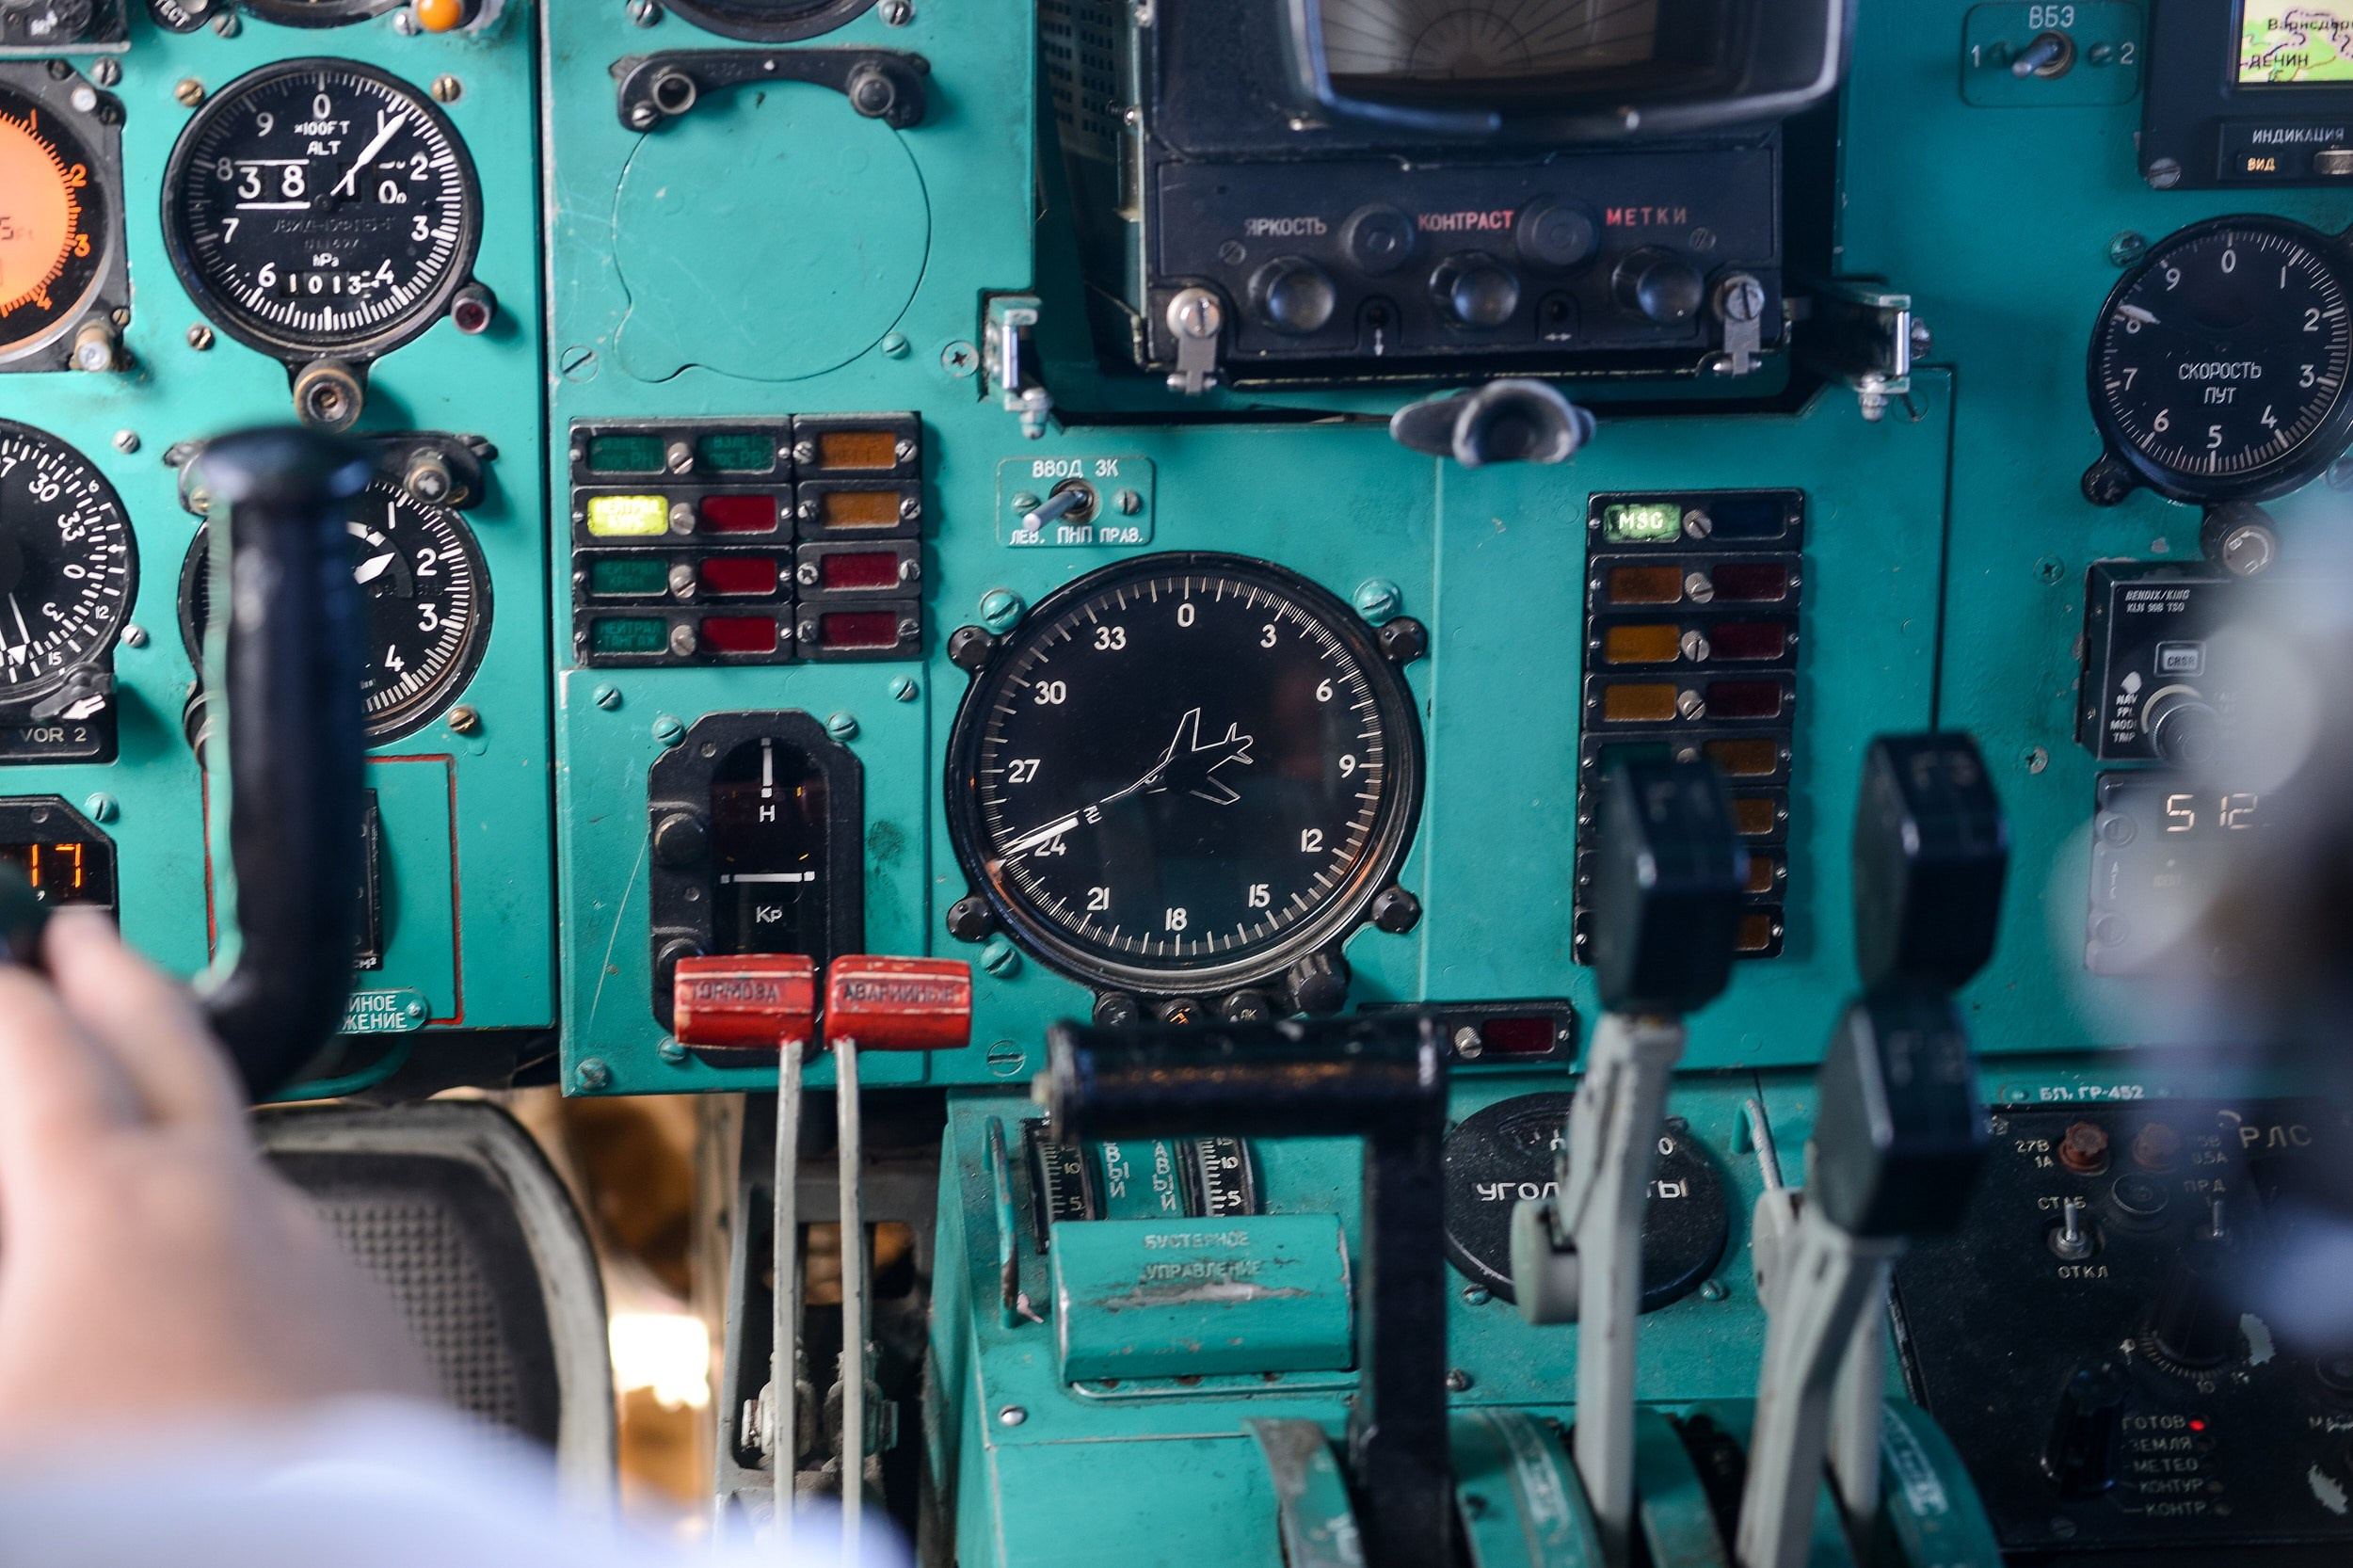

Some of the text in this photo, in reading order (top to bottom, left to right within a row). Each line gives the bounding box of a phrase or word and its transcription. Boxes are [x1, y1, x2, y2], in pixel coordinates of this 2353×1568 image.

[1972, 44, 1980, 68] 1
[2121, 41, 2135, 64] 2
[312, 94, 331, 120] 0
[257, 112, 274, 136] 9
[2252, 128, 2344, 144] ИНДИКАЦИЯ
[307, 140, 341, 155] ALT
[216, 157, 233, 181] 8
[409, 152, 429, 181] 2
[2248, 157, 2275, 171] ВИД
[1244, 216, 1327, 236] ЯРКОСТЬ
[1417, 209, 1513, 232] КОНТРАСТ
[1606, 207, 1687, 226] МЕТКИ
[221, 217, 240, 244] 7
[411, 216, 430, 241] 3
[312, 253, 340, 267] hPa
[2221, 248, 2236, 273] 0
[258, 262, 277, 287] 6
[376, 259, 394, 285] 4
[2166, 268, 2182, 292] 9
[2280, 265, 2287, 289] 1
[2303, 308, 2320, 331] 2
[2122, 368, 2138, 392] 7
[2178, 361, 2263, 380] СКОРОСТЬ
[2299, 364, 2315, 389] 3
[2203, 387, 2237, 405] ПУТ
[2153, 408, 2170, 433] 6
[2261, 405, 2278, 428] 4
[2206, 424, 2222, 449] 5
[1032, 459, 1118, 478] ВВОД ЗК
[28, 472, 60, 502] 30
[57, 510, 86, 542] 33
[388, 501, 395, 530] 1
[1618, 511, 1663, 530] MSG
[1057, 526, 1092, 545] ПНП
[1099, 527, 1143, 543] ПРАВ.
[63, 565, 86, 579] 0
[417, 548, 437, 576] 2
[2125, 589, 2191, 601] BENDIX/KING
[41, 601, 65, 621] 3
[95, 605, 109, 619] 12
[418, 603, 439, 632] 3
[1177, 603, 1195, 627] 0
[1095, 627, 1126, 650] 33
[1260, 624, 1277, 648] 3
[48, 651, 62, 665] 15
[385, 644, 405, 672] 4
[1034, 680, 1066, 704] 30
[1316, 679, 1333, 702] 6
[2116, 695, 2137, 706] NAV
[22, 728, 88, 743] VOR 2
[2112, 732, 2137, 743] TRIP
[1008, 760, 1040, 783] 27
[1339, 755, 1356, 777] 9
[759, 806, 776, 823] Н
[1034, 834, 1066, 856] 24
[1302, 829, 1323, 852] 12
[1088, 888, 1110, 910] 21
[1249, 885, 1271, 907] 15
[756, 905, 783, 924] Кр
[1165, 908, 1187, 931] 18
[692, 984, 780, 1003] ТОРМОЗА
[2078, 1085, 2145, 1100] ГР-452
[2015, 1140, 2050, 1153] 27В
[2240, 1125, 2313, 1149] РЛС
[1064, 1161, 1081, 1175] 10
[1103, 1142, 1130, 1199] ВЫЙ
[1222, 1157, 1239, 1169] 10
[2035, 1155, 2055, 1168] 1А
[1069, 1196, 1082, 1210] 5
[1227, 1191, 1241, 1207] 5
[1476, 1182, 1561, 1202] УГОЛ
[1144, 1230, 1250, 1250] БУСТЕРНОЕ
[1144, 1260, 1262, 1281] УПРАВЛЕНИЕ
[2057, 1265, 2108, 1279] ОТКЛ
[2121, 1415, 2185, 1430] ГОТОВ
[2129, 1436, 2193, 1452] ЗЕМЛЯ
[2133, 1457, 2199, 1474] МЕТЕО
[2139, 1478, 2204, 1495] КОНТУР
